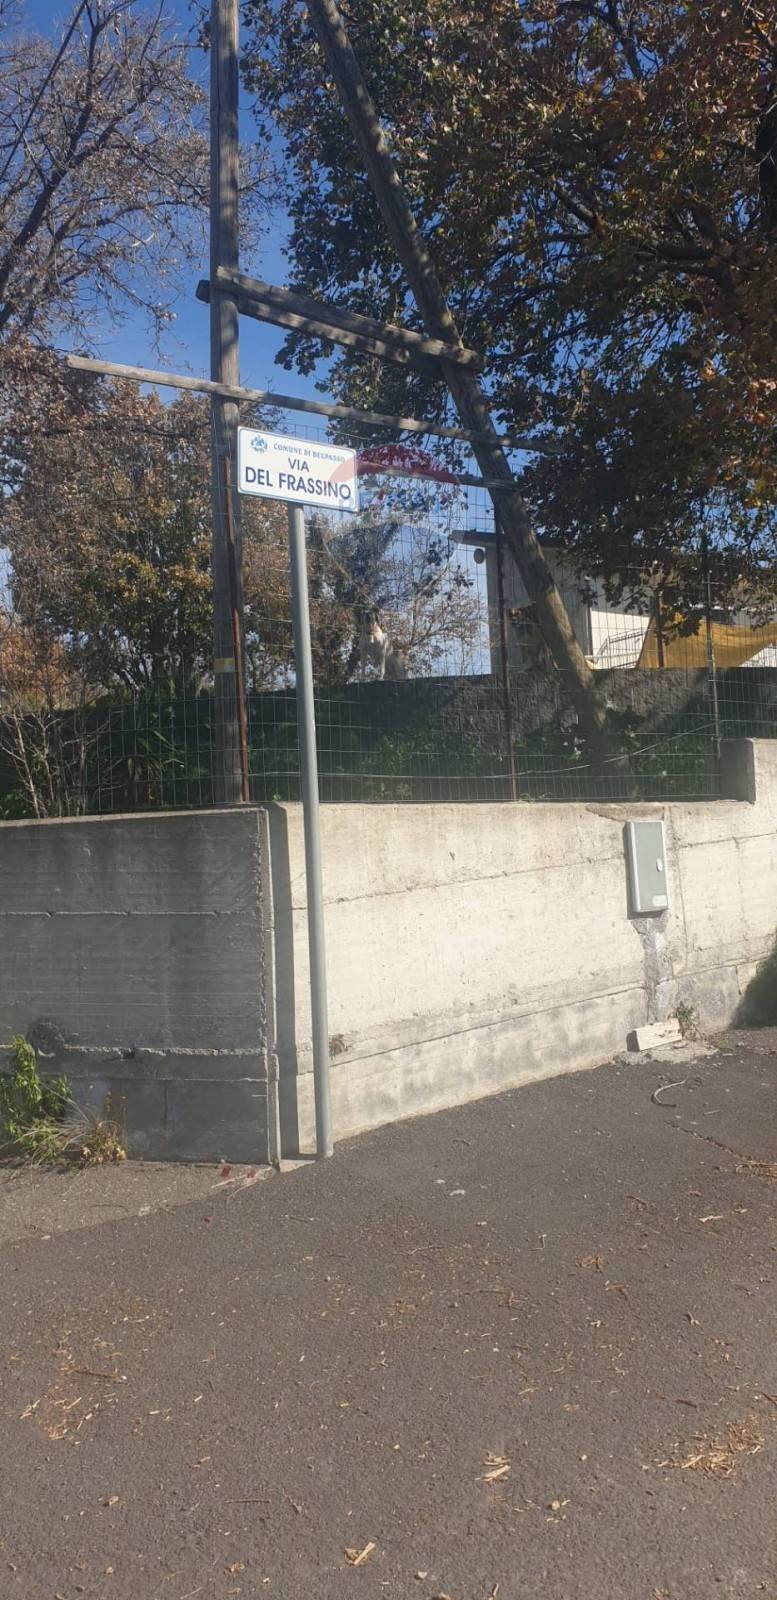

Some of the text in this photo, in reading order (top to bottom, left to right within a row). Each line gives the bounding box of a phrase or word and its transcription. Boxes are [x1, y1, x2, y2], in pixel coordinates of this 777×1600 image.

[273, 443, 302, 455] COMUNE
[304, 448, 311, 456] DI
[288, 457, 310, 472] VIA
[245, 466, 351, 499] DEL FRASSINO
